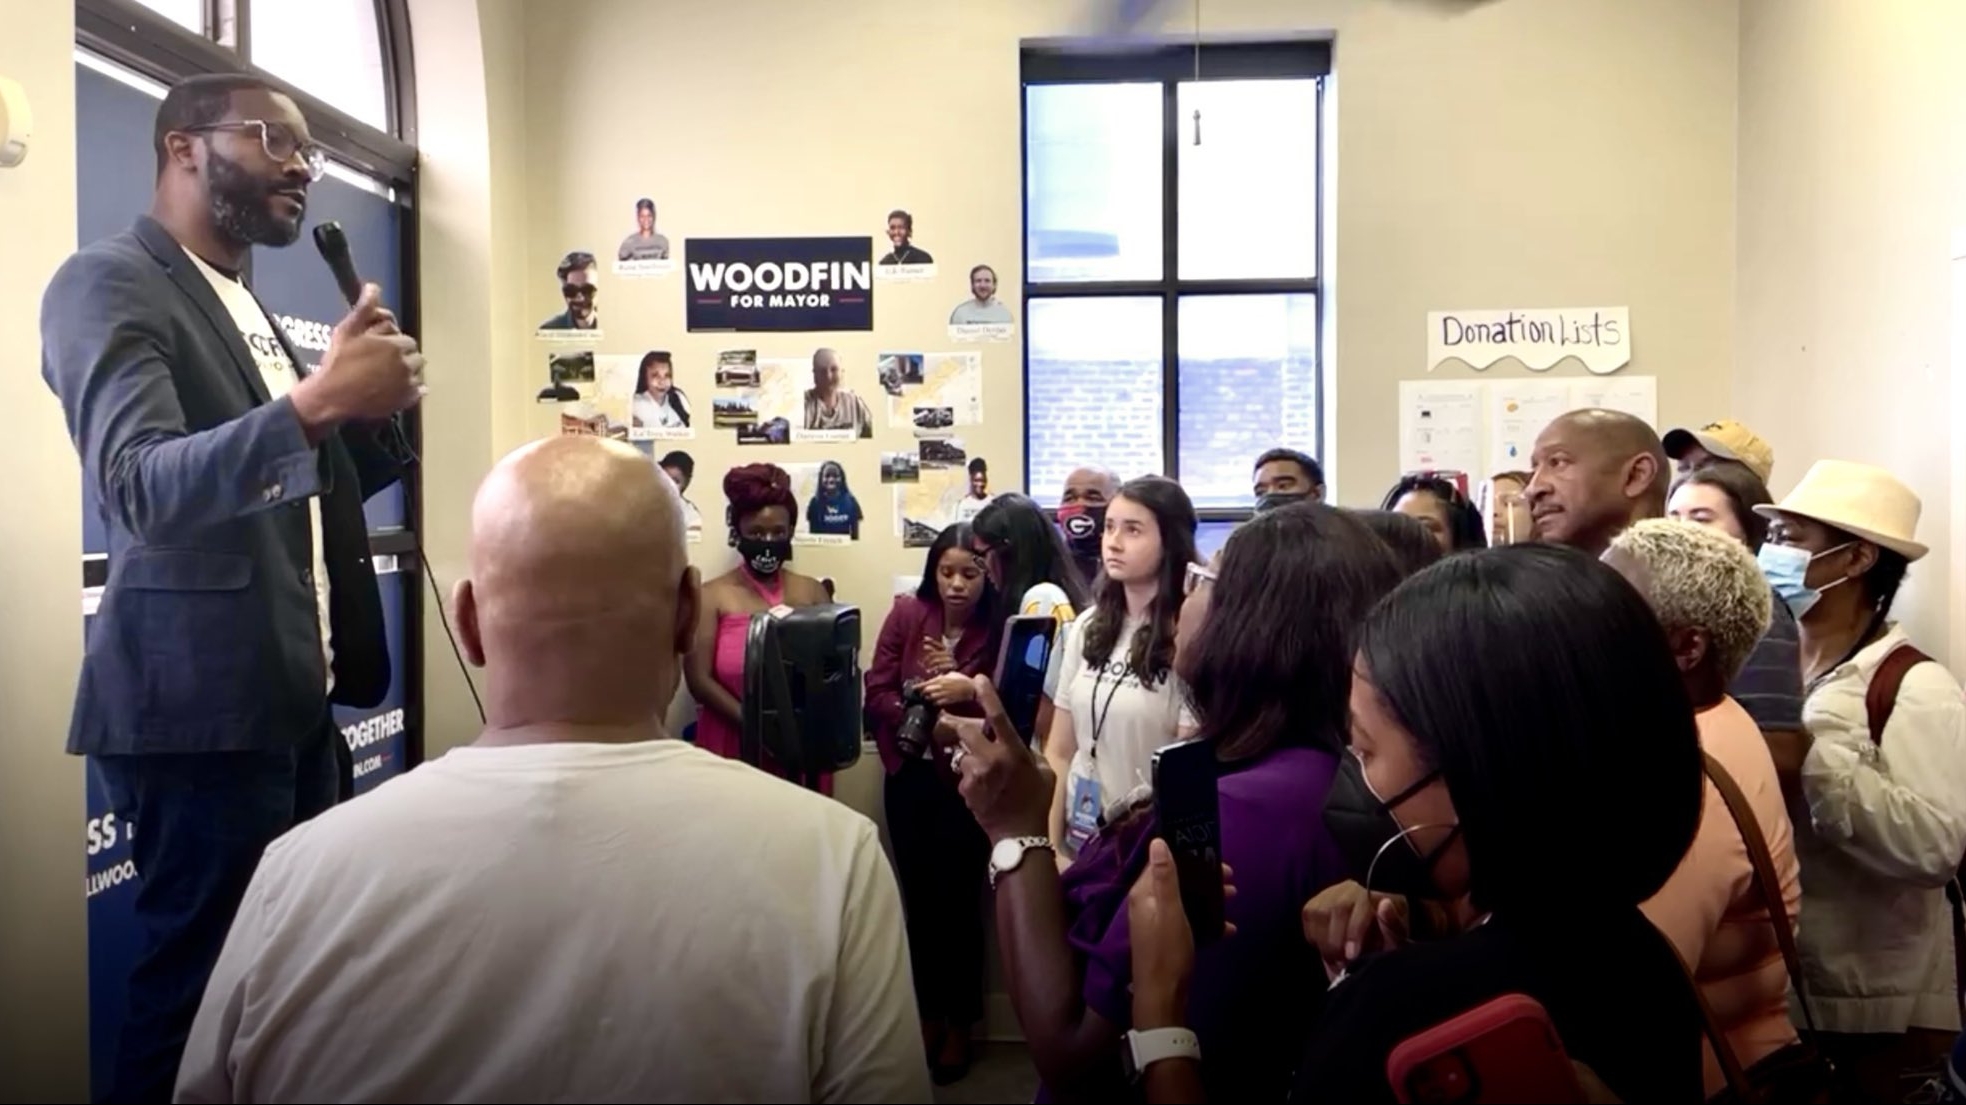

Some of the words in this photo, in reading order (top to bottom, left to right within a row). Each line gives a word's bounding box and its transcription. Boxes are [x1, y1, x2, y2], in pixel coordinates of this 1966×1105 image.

[689, 262, 871, 292] WOODFIN
[730, 294, 764, 308] FOR
[769, 293, 831, 308] MAYOR
[273, 313, 332, 352] GRESS
[1443, 311, 1555, 346] Donation
[1559, 311, 1621, 347] Lists
[86, 859, 138, 897] LLWOO
